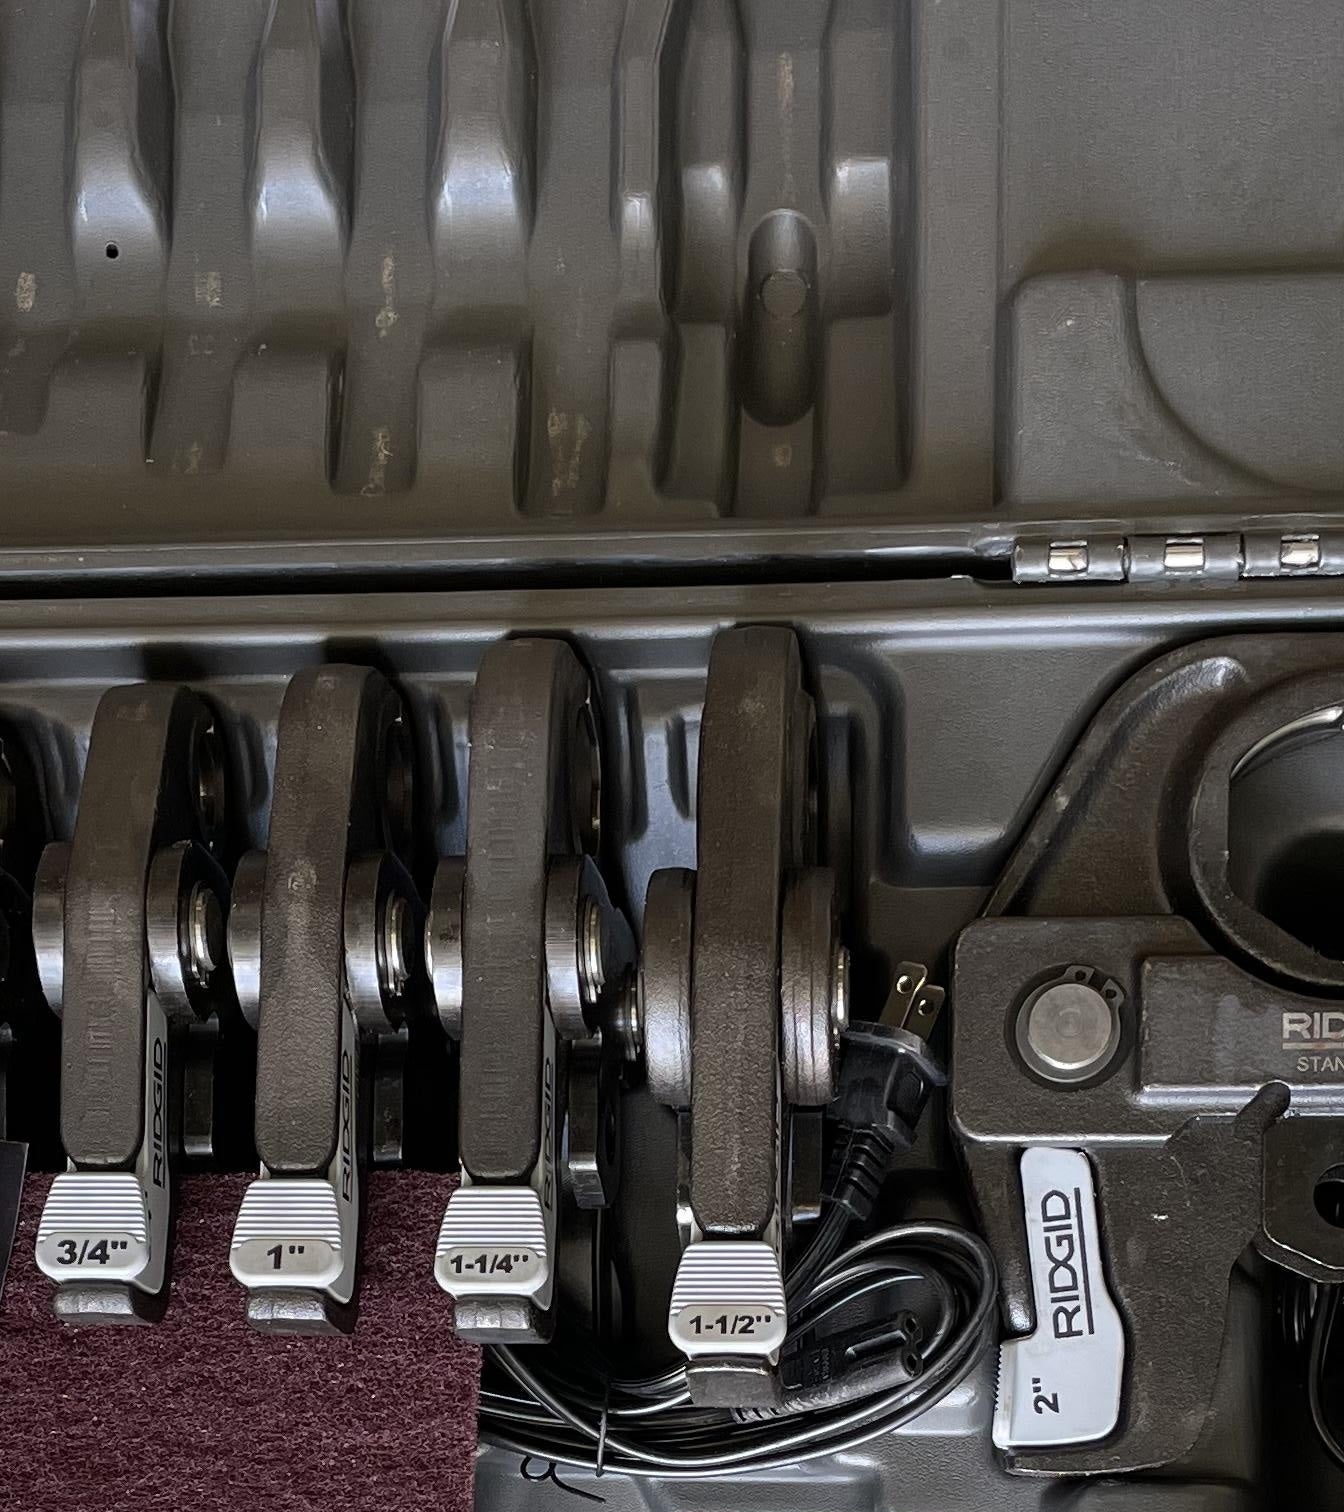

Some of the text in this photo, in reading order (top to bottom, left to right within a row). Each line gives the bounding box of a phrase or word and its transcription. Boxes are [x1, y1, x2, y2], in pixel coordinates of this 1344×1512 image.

[153, 1036, 163, 1188] RIDGID
[56, 1239, 129, 1266] 3/4"
[266, 1244, 305, 1270] 1"
[450, 1254, 529, 1274] 1-1/4"
[1041, 1189, 1084, 1339] RIDGID
[689, 1314, 772, 1335] 1-1/2"
[1031, 1377, 1060, 1414] 2"
